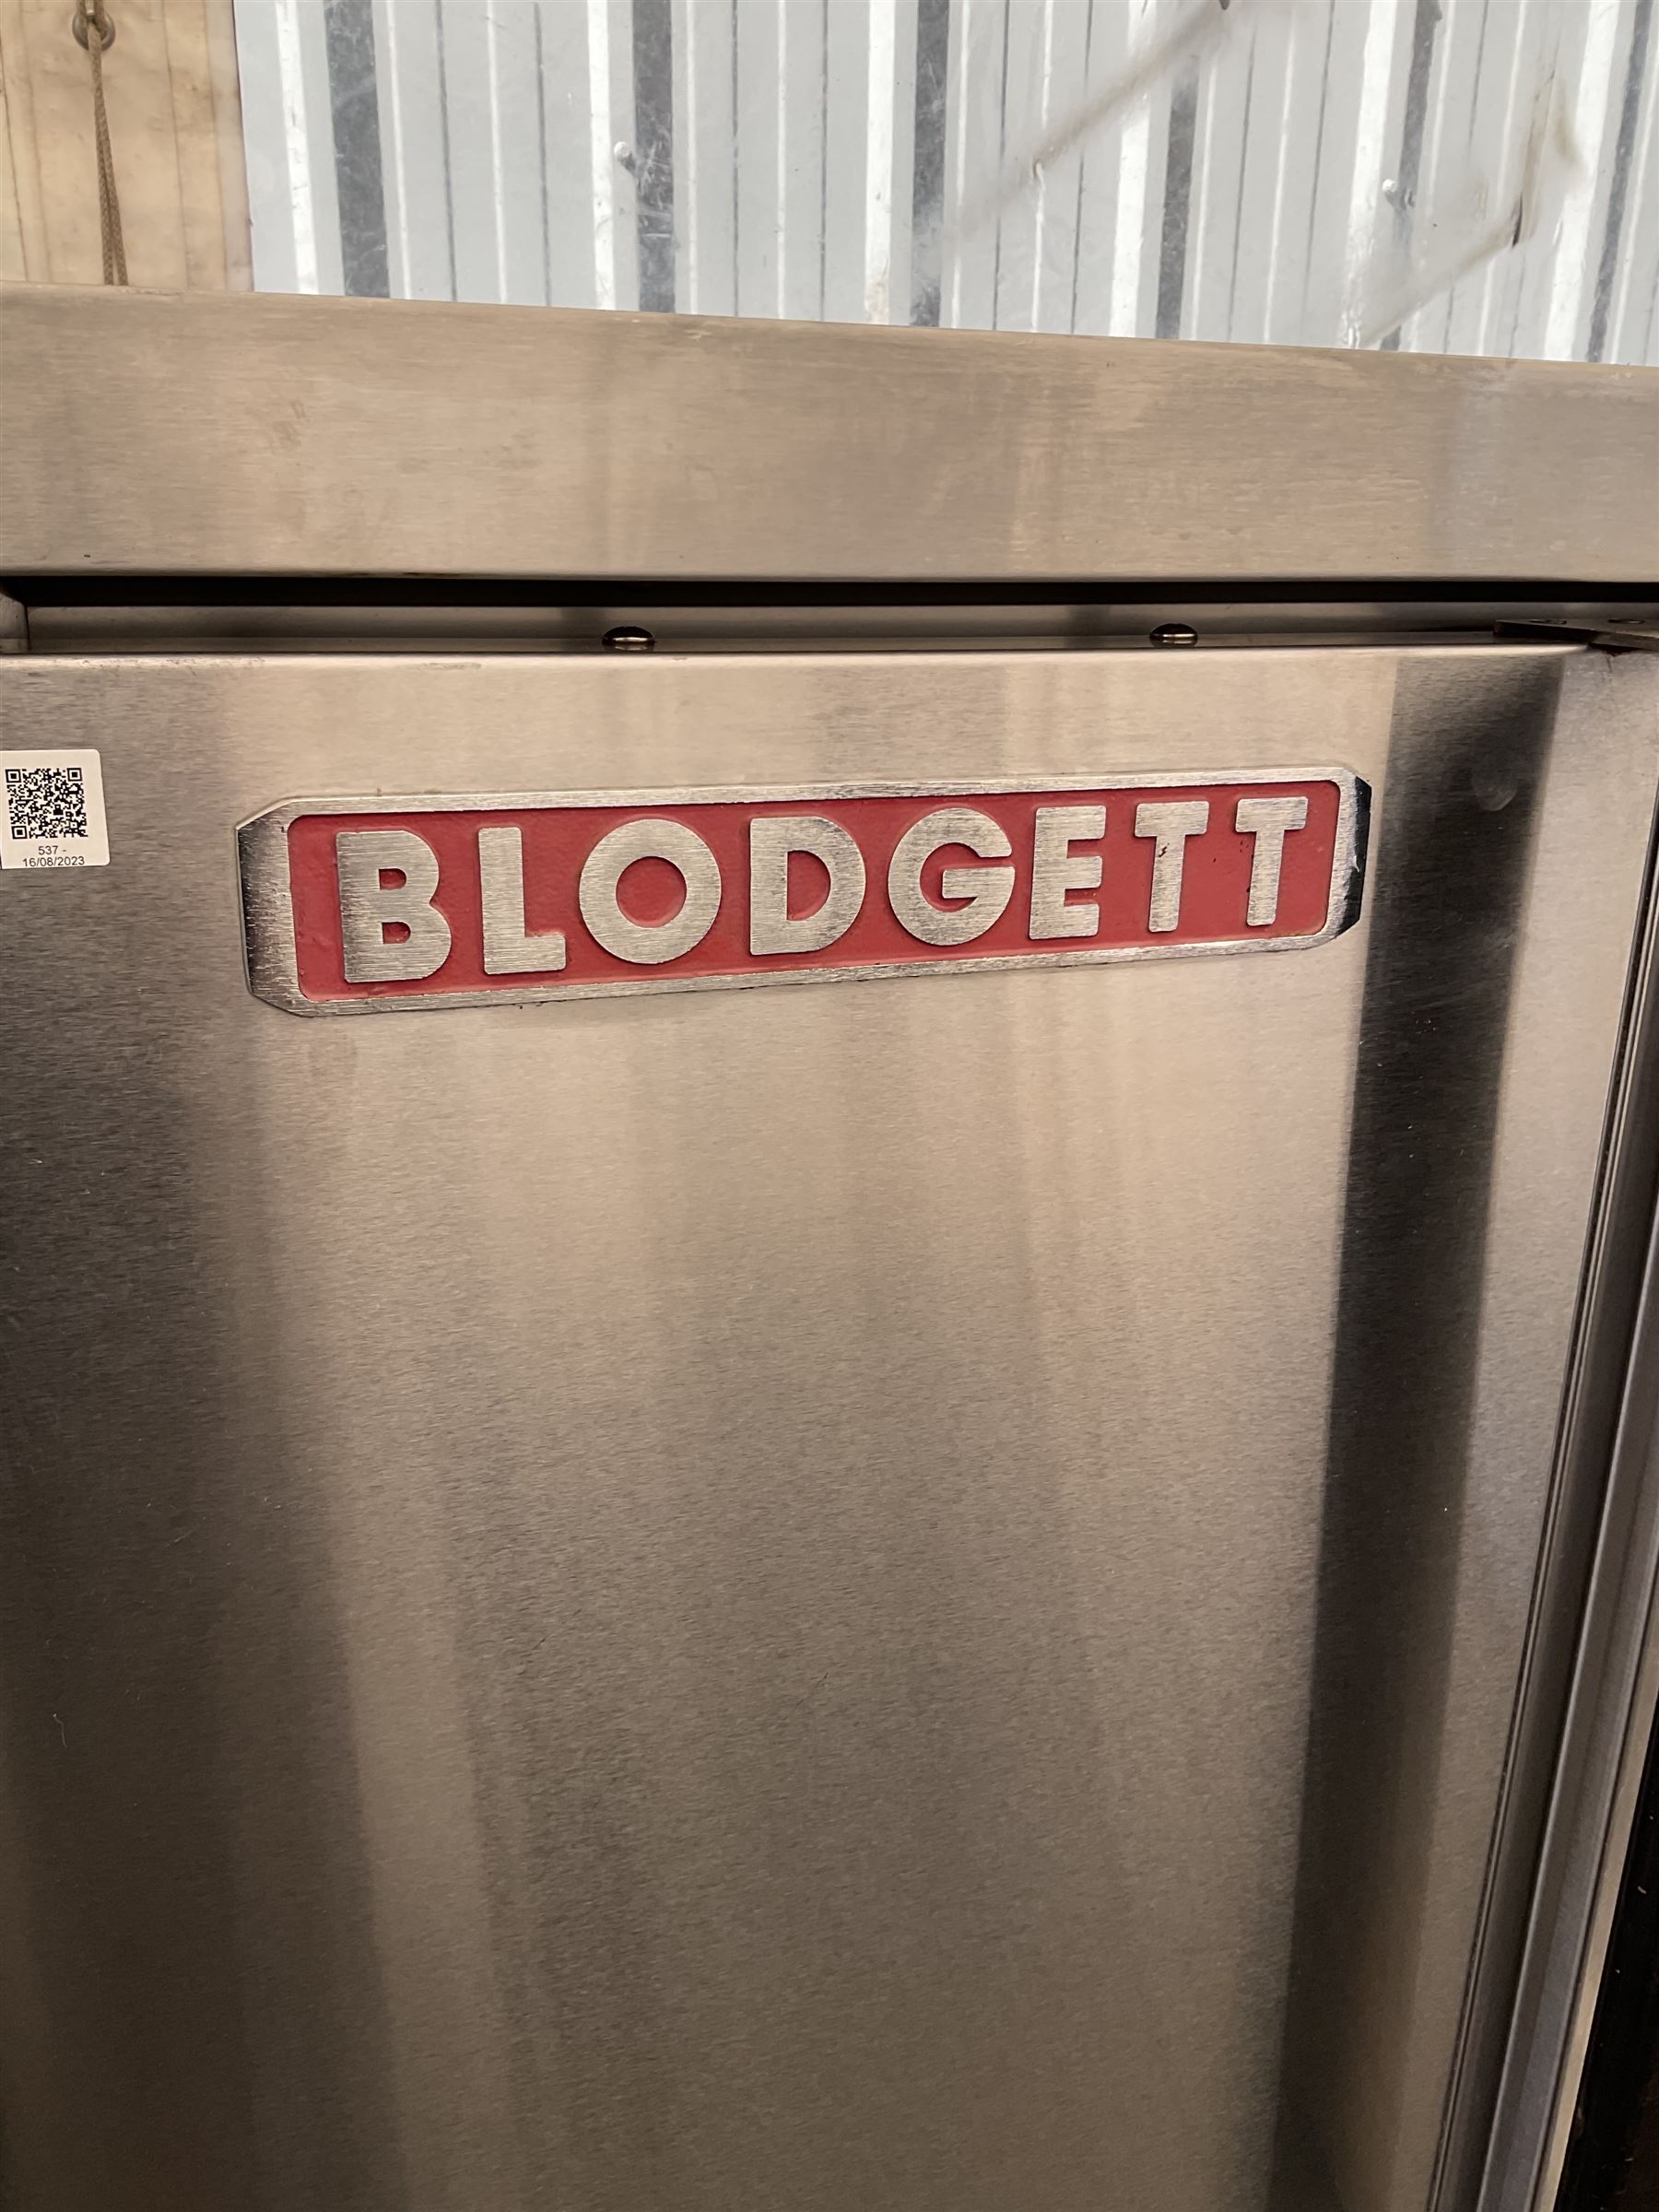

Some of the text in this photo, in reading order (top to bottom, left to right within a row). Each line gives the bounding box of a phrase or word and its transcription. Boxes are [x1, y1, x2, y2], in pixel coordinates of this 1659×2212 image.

[38, 845, 58, 855] 537
[22, 856, 85, 867] 16/08/2023
[335, 795, 1308, 983] BLODGETT
